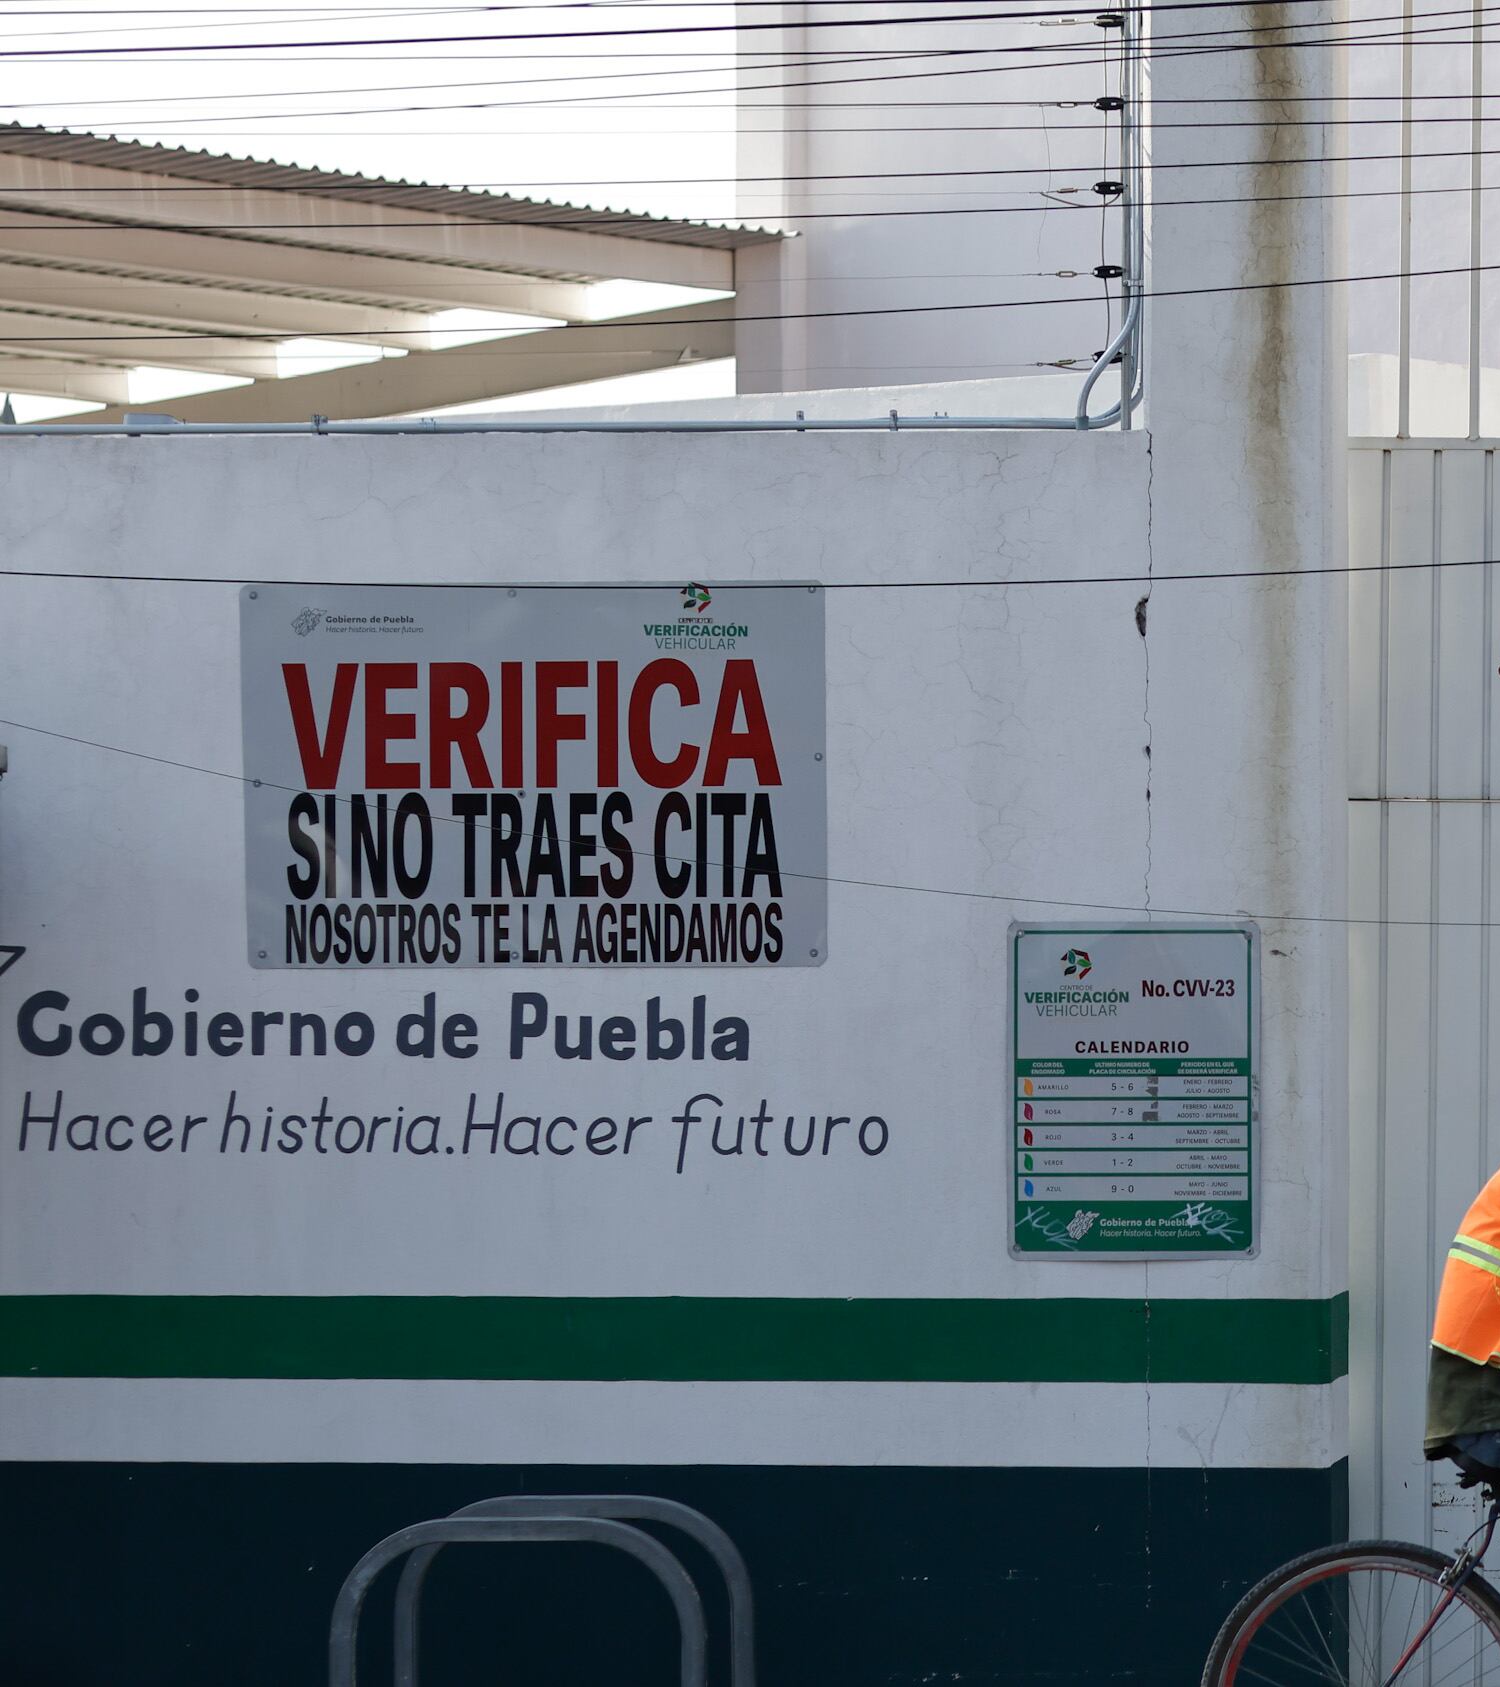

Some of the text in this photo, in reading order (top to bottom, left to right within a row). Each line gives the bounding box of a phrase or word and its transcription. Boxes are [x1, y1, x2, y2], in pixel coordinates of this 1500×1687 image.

[325, 615, 414, 624] Gobierno de Puebla
[643, 622, 748, 637] VERIFICACIÓN
[654, 637, 736, 650] VEHICULAR
[281, 658, 782, 789] VERIFICA
[287, 792, 782, 900] SI NO TRAES CITA
[285, 903, 783, 965] NOSOTROS TE LA AGENDAMOS
[1141, 978, 1236, 998] No. CVV-23
[1024, 988, 1130, 1004] VERIFICACIÓN
[1036, 1004, 1118, 1017] VEHICULAR
[16, 988, 751, 1062] Gobierno de Puebla
[1075, 1040, 1190, 1055] CALENDARIO
[1111, 1082, 1134, 1091] 5 6
[1111, 1107, 1134, 1116] 7 8
[18, 1091, 207, 1155] Hacer
[461, 1092, 657, 1159] Hacer
[672, 1094, 889, 1173] futuro
[1111, 1133, 1134, 1141] 3 4
[1127, 1159, 1133, 1167] 2
[1111, 1185, 1134, 1193] 9 0
[1100, 1218, 1142, 1227] Gobierno
[1145, 1218, 1156, 1227] de
[1100, 1229, 1121, 1237] Hacer
[1154, 1229, 1176, 1237] Hacer
